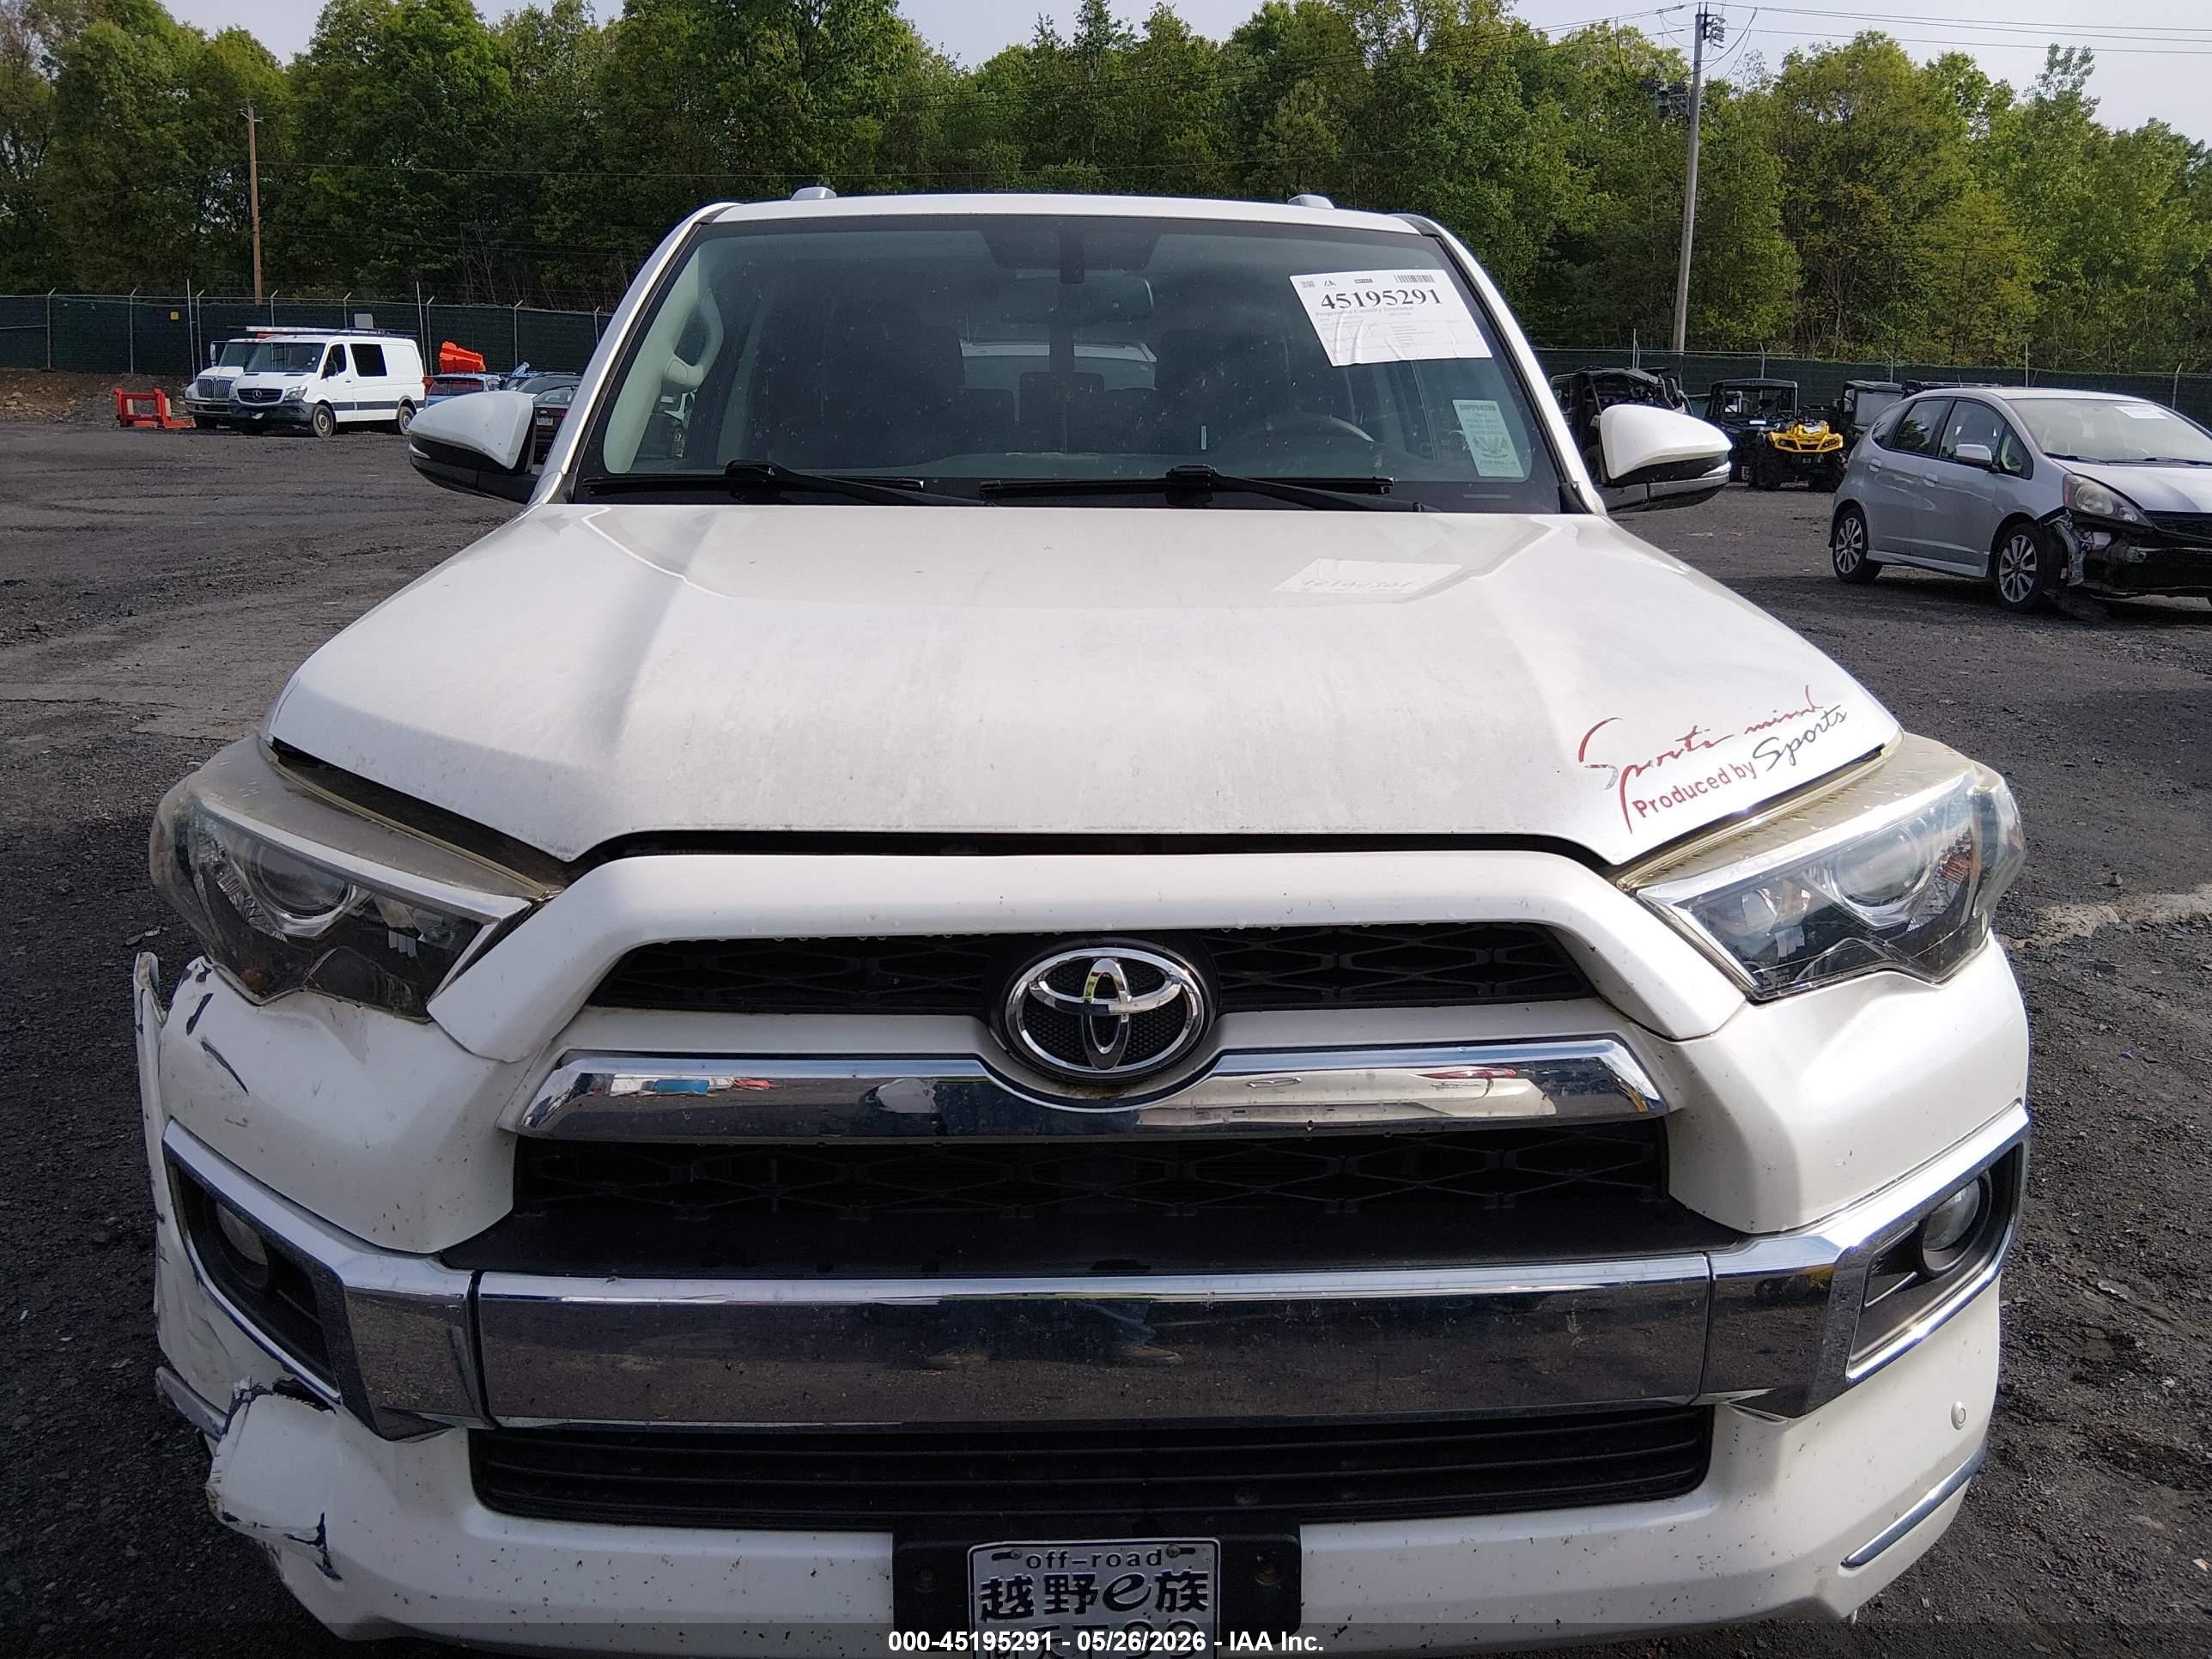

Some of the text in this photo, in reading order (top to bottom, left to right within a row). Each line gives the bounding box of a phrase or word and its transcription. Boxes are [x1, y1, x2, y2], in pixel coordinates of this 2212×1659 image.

[1321, 289, 1443, 310] 45195291
[1743, 684, 1823, 734] mind
[1632, 704, 1848, 818] Produced by Sports
[1026, 1547, 1163, 1570] off-road
